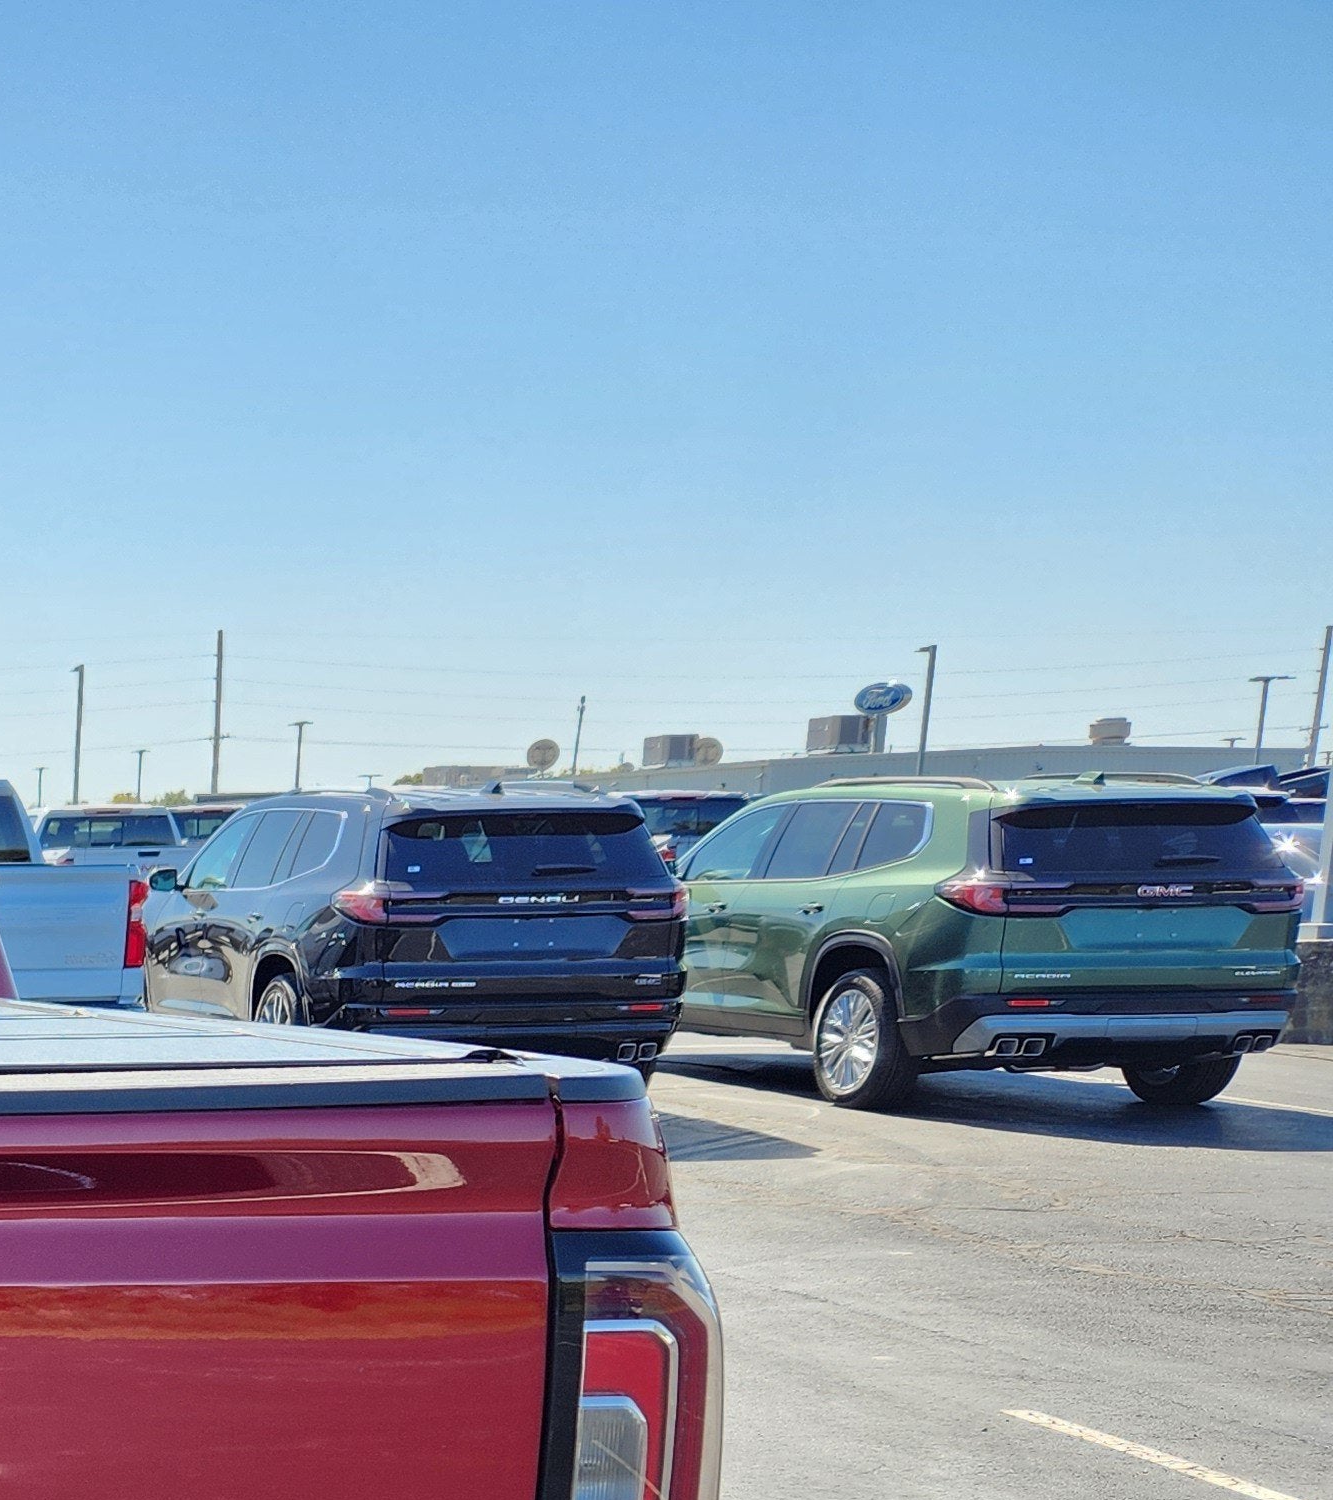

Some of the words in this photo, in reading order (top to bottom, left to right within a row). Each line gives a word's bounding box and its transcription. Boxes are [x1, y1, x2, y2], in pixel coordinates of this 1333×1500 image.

[863, 690, 895, 709] Ford
[1137, 884, 1194, 898] GMC
[498, 895, 580, 904] DENALI
